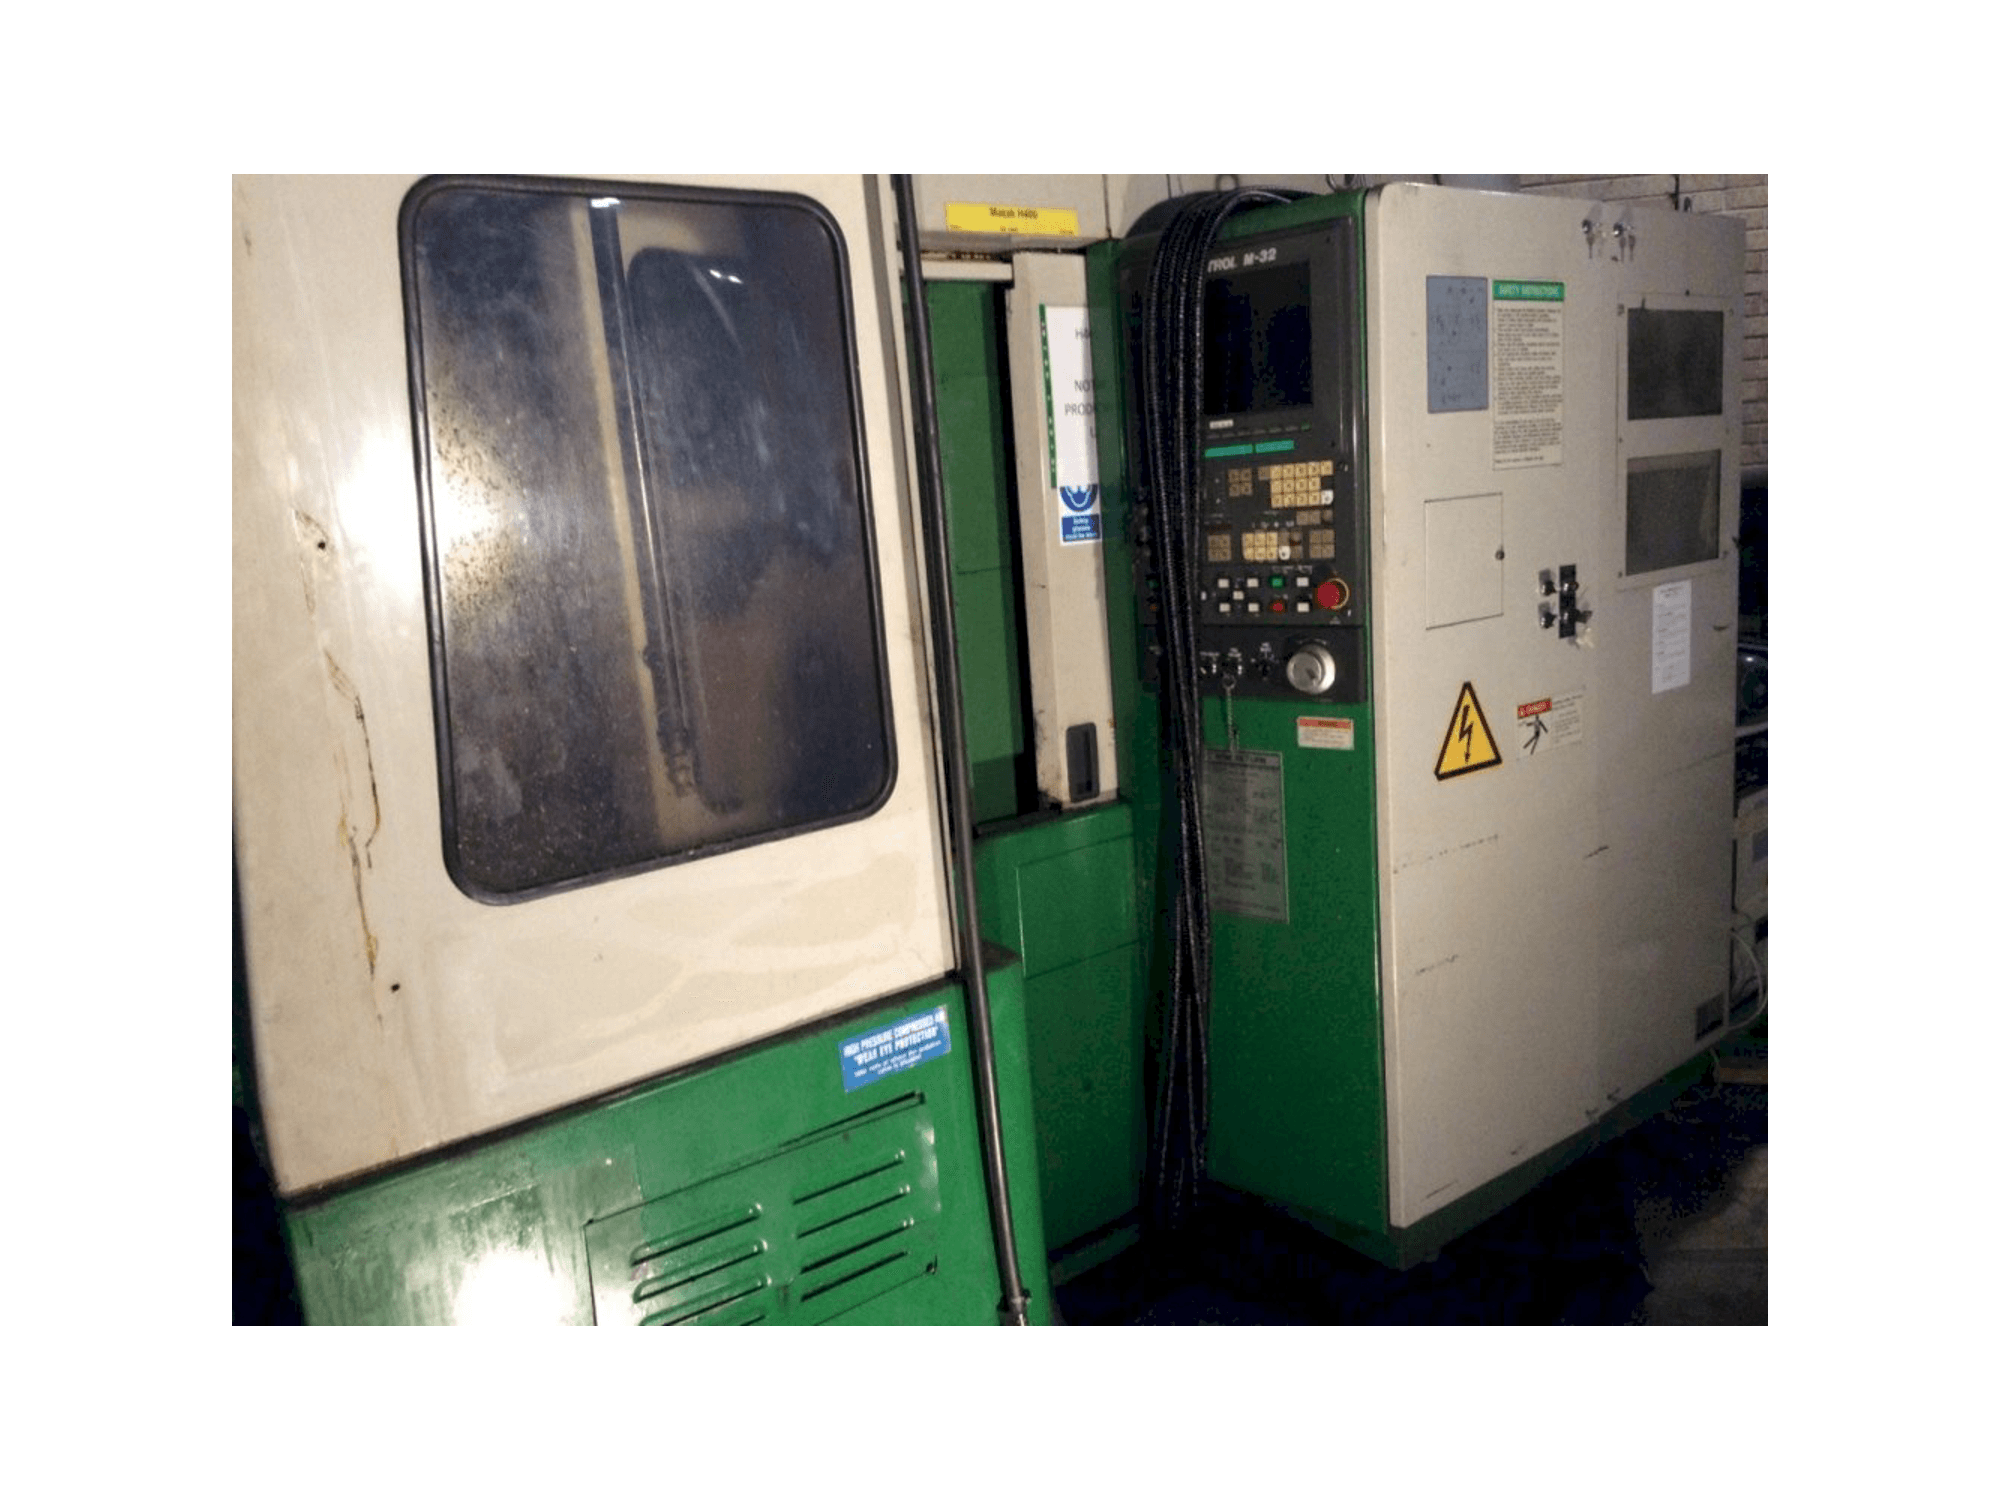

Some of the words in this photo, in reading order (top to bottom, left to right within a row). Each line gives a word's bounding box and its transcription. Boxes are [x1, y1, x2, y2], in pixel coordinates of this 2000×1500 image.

[1206, 256, 1238, 273] TROL
[1243, 247, 1277, 267] M-32
[861, 1029, 893, 1052] PRESSURE
[894, 1014, 934, 1039] COMPRESSED
